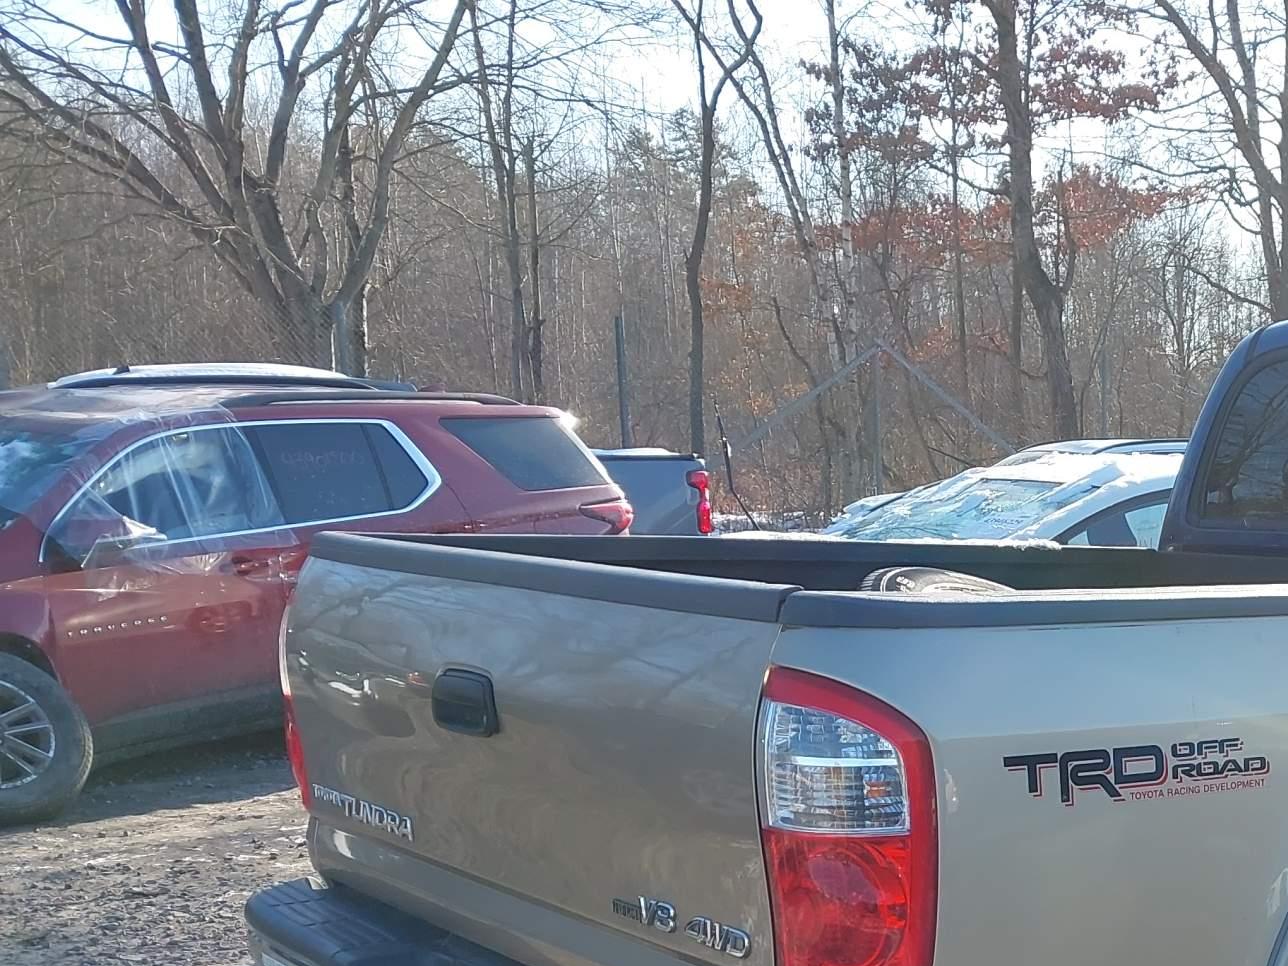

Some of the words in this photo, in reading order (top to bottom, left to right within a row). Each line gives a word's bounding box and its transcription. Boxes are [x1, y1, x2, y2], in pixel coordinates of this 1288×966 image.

[1171, 738, 1244, 761] OFF
[1003, 744, 1168, 806] TRD
[1171, 756, 1270, 783] ROAD
[1130, 788, 1165, 801] TOYOTA
[1167, 784, 1201, 797] RACING
[1203, 778, 1266, 794] DEVELOPMENT
[340, 794, 414, 841] TUNDRA
[638, 895, 676, 933] V8
[684, 916, 752, 959] 4WD
